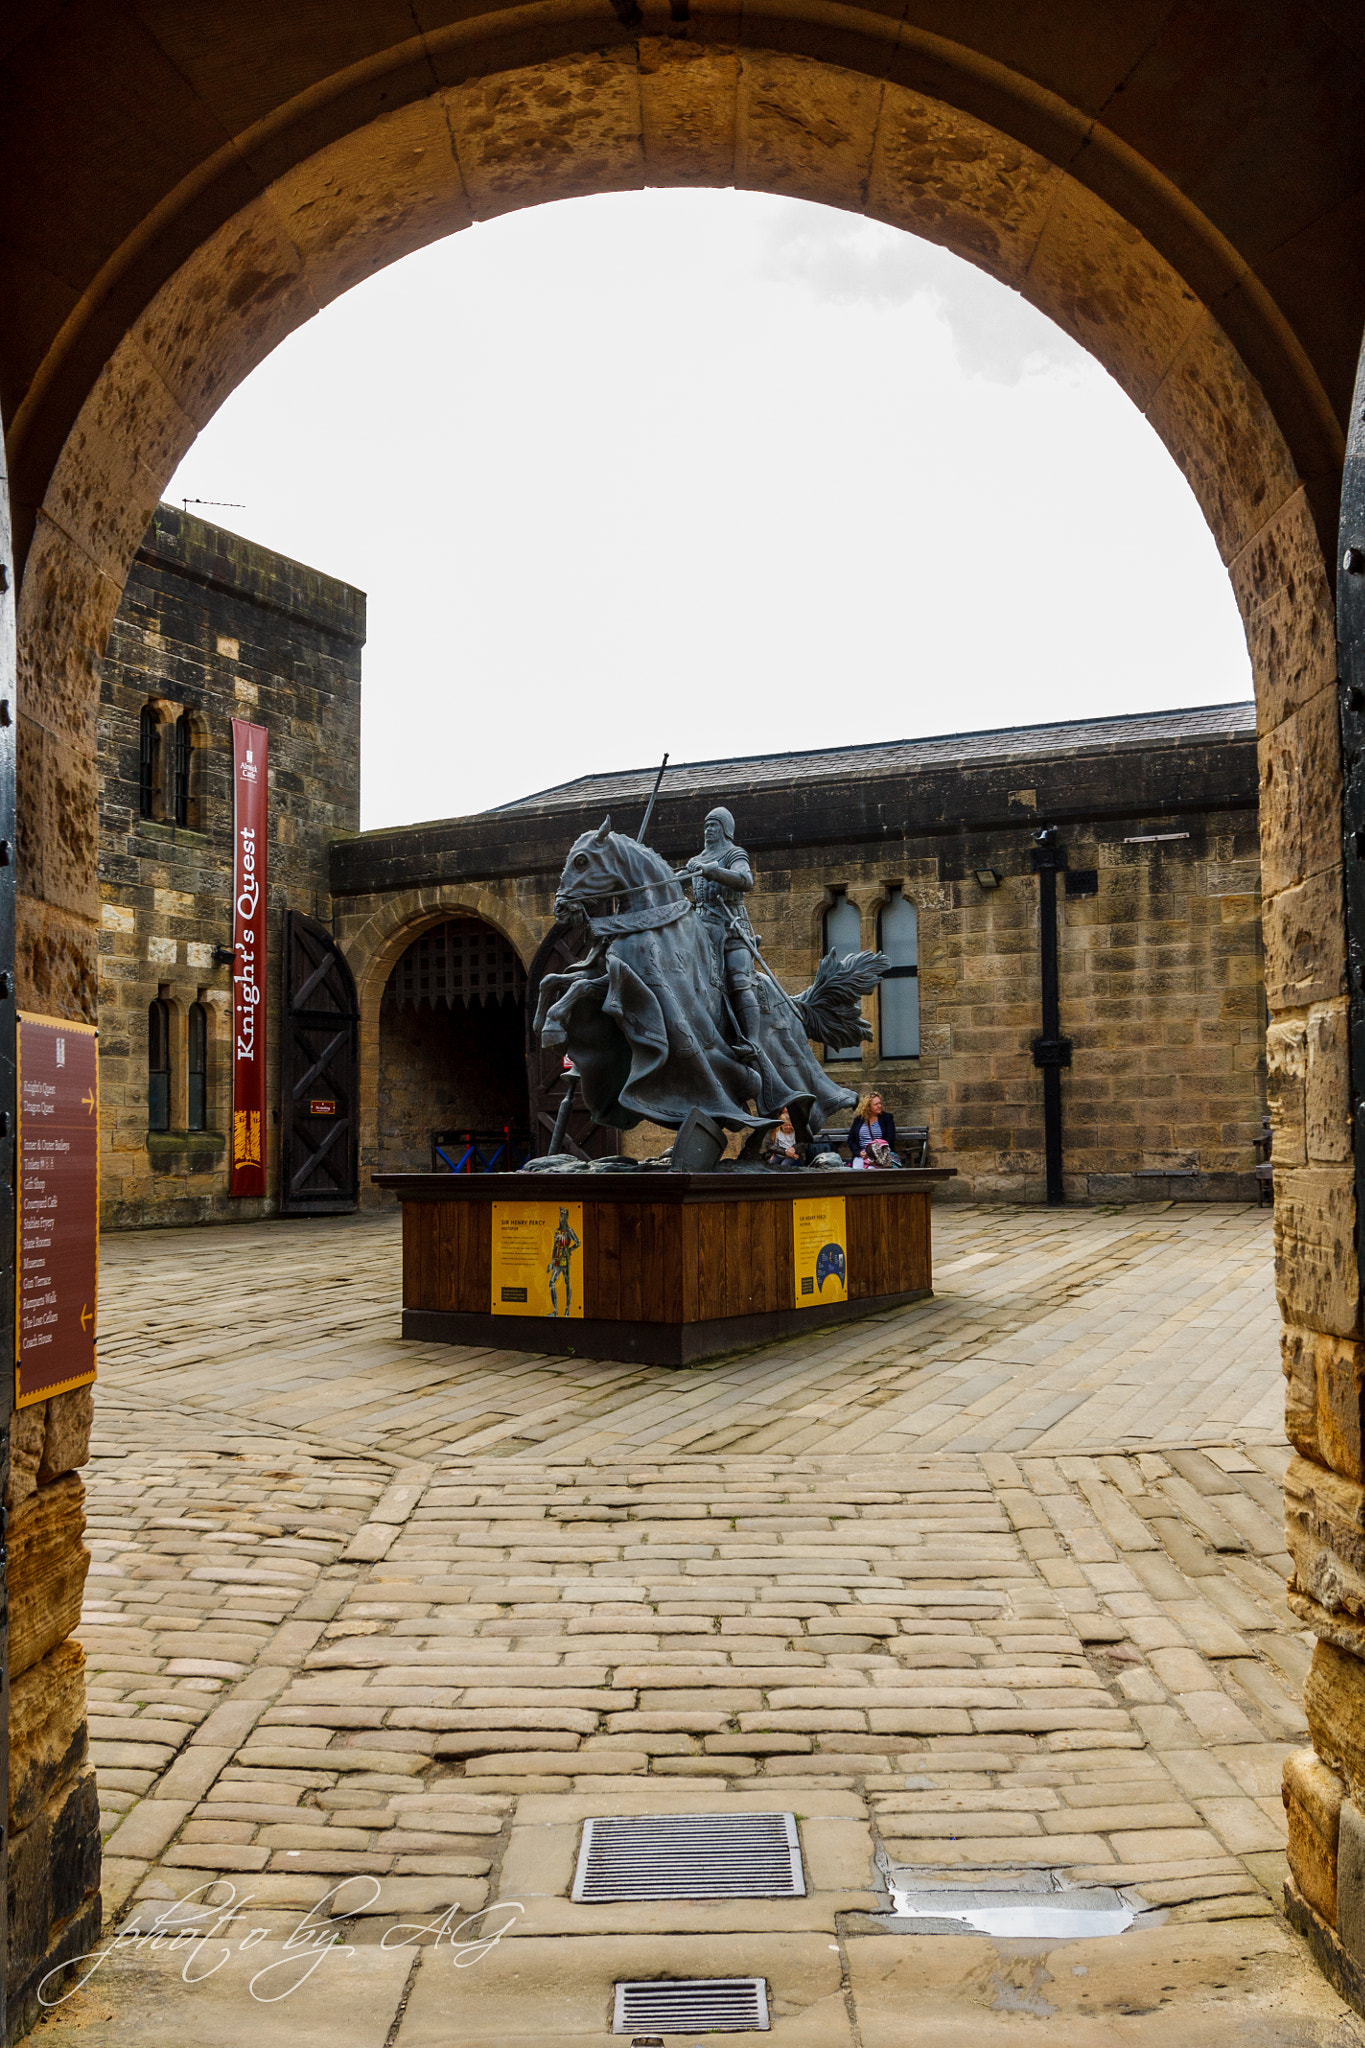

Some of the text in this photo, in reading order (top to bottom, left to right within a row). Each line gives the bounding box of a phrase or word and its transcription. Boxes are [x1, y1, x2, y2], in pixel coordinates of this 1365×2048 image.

[233, 827, 260, 1061] Knight's Quest
[42, 1083, 56, 1096] Quest
[24, 1100, 54, 1116] Dragon Quest
[24, 1139, 36, 1150] Inner
[42, 1140, 54, 1150] Outer
[55, 1138, 70, 1154] Baileys
[24, 1157, 39, 1170] Toilets
[24, 1176, 45, 1193] Gift Shop
[24, 1196, 47, 1212] Courtyard
[24, 1216, 39, 1229] Stables
[24, 1237, 51, 1249] State Rooms
[23, 1258, 45, 1269] Museums
[23, 1276, 51, 1289] Gun Terrace
[45, 1291, 57, 1304] Walk
[23, 1311, 58, 1329] The Lost Cellars
[23, 1333, 52, 1349] Coach House
